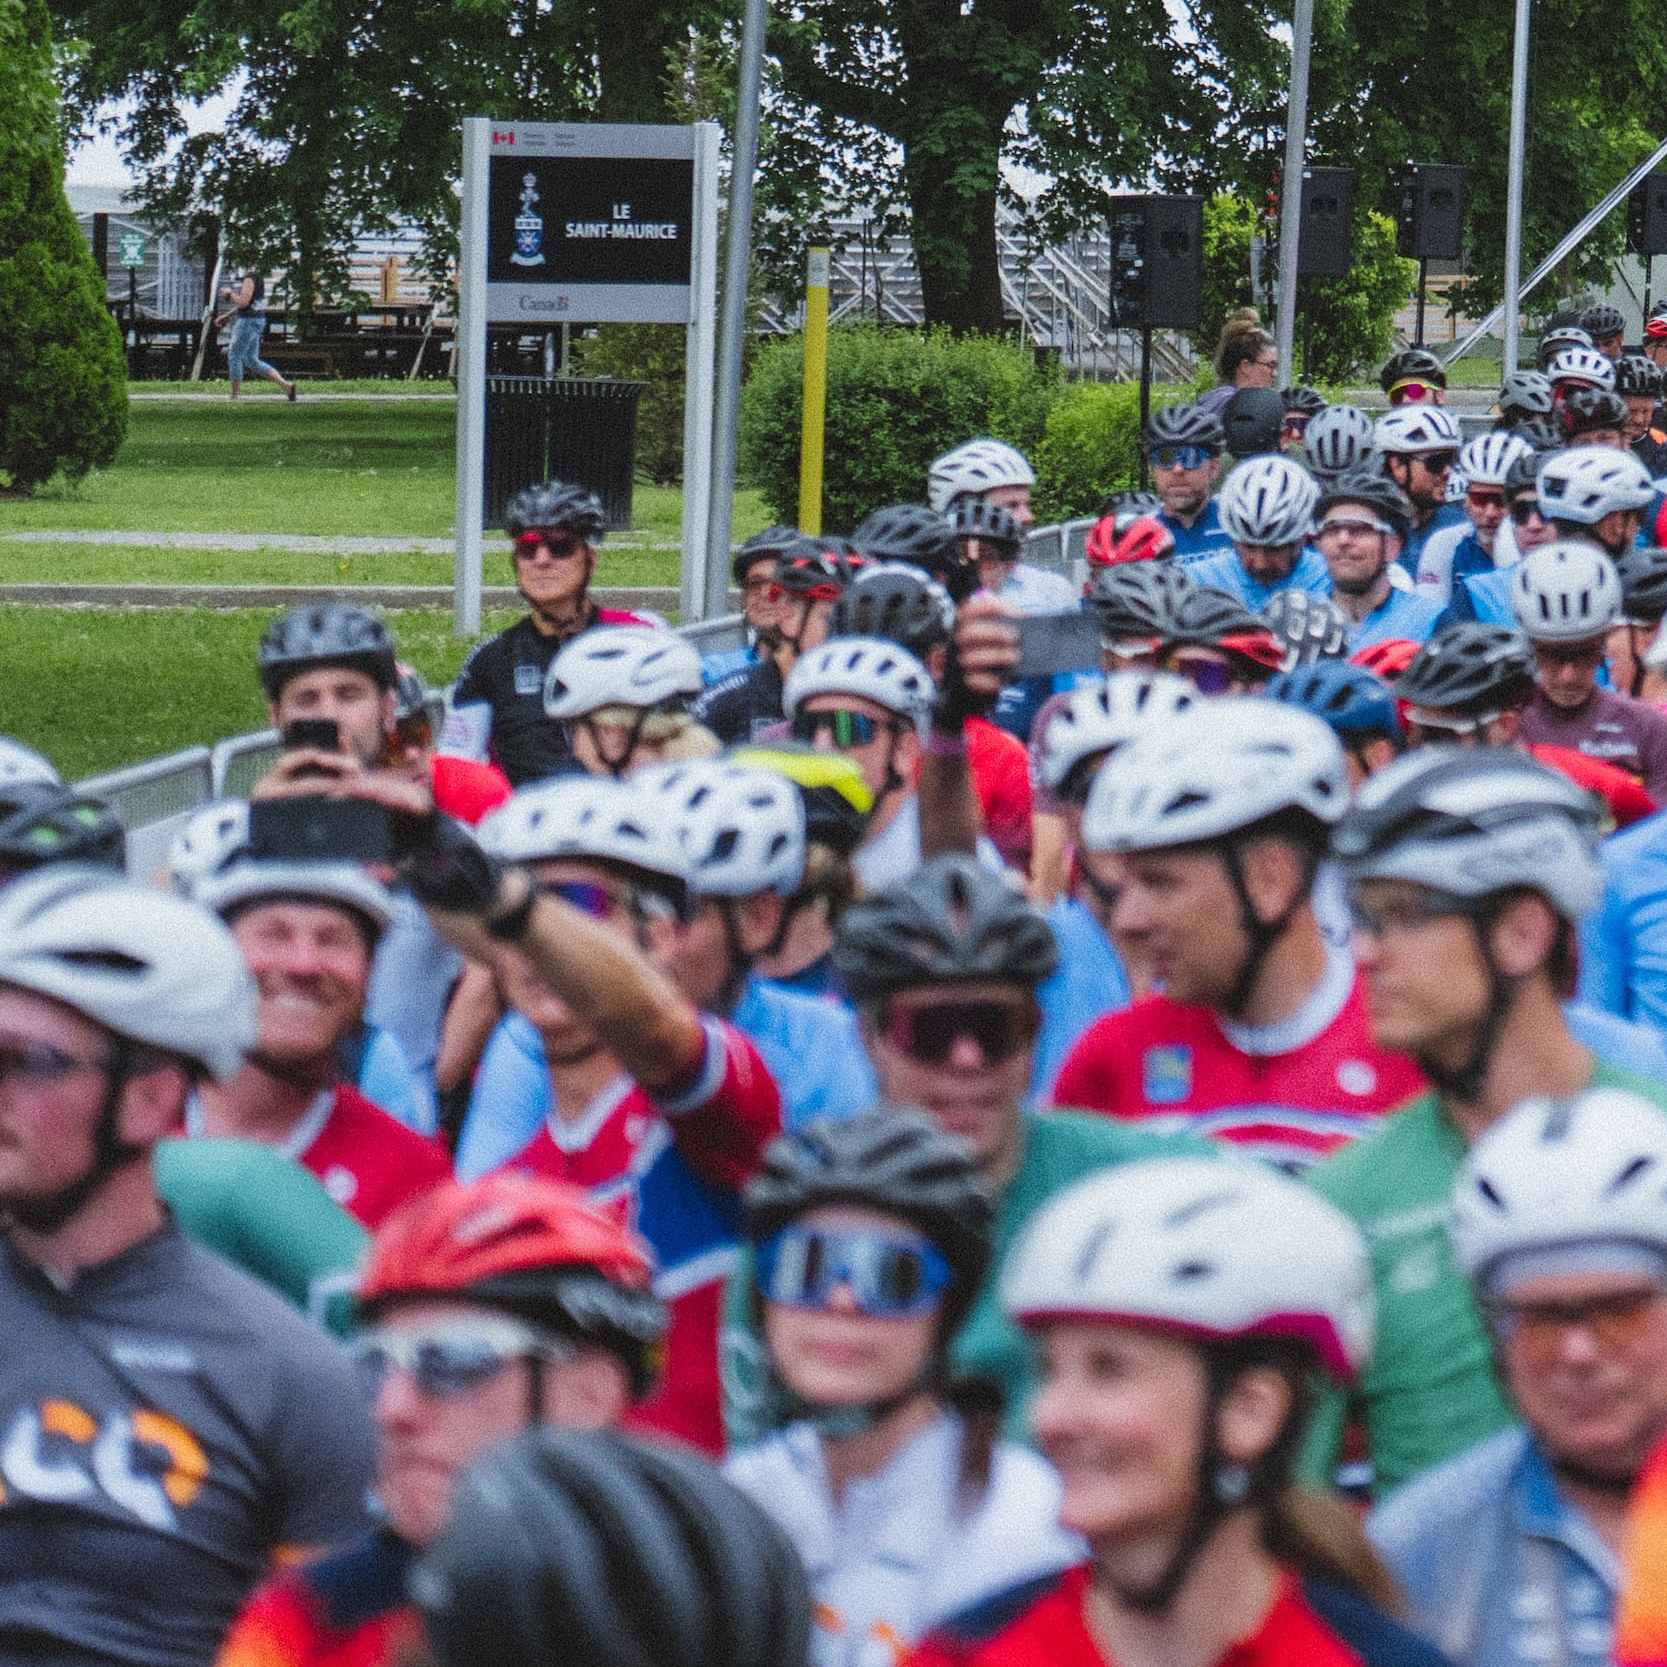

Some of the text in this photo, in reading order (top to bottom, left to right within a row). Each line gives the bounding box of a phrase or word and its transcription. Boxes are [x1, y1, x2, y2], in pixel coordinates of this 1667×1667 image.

[612, 202, 631, 220] LE
[565, 221, 678, 240] SAINT-MAURICE
[518, 296, 570, 312] Canada
